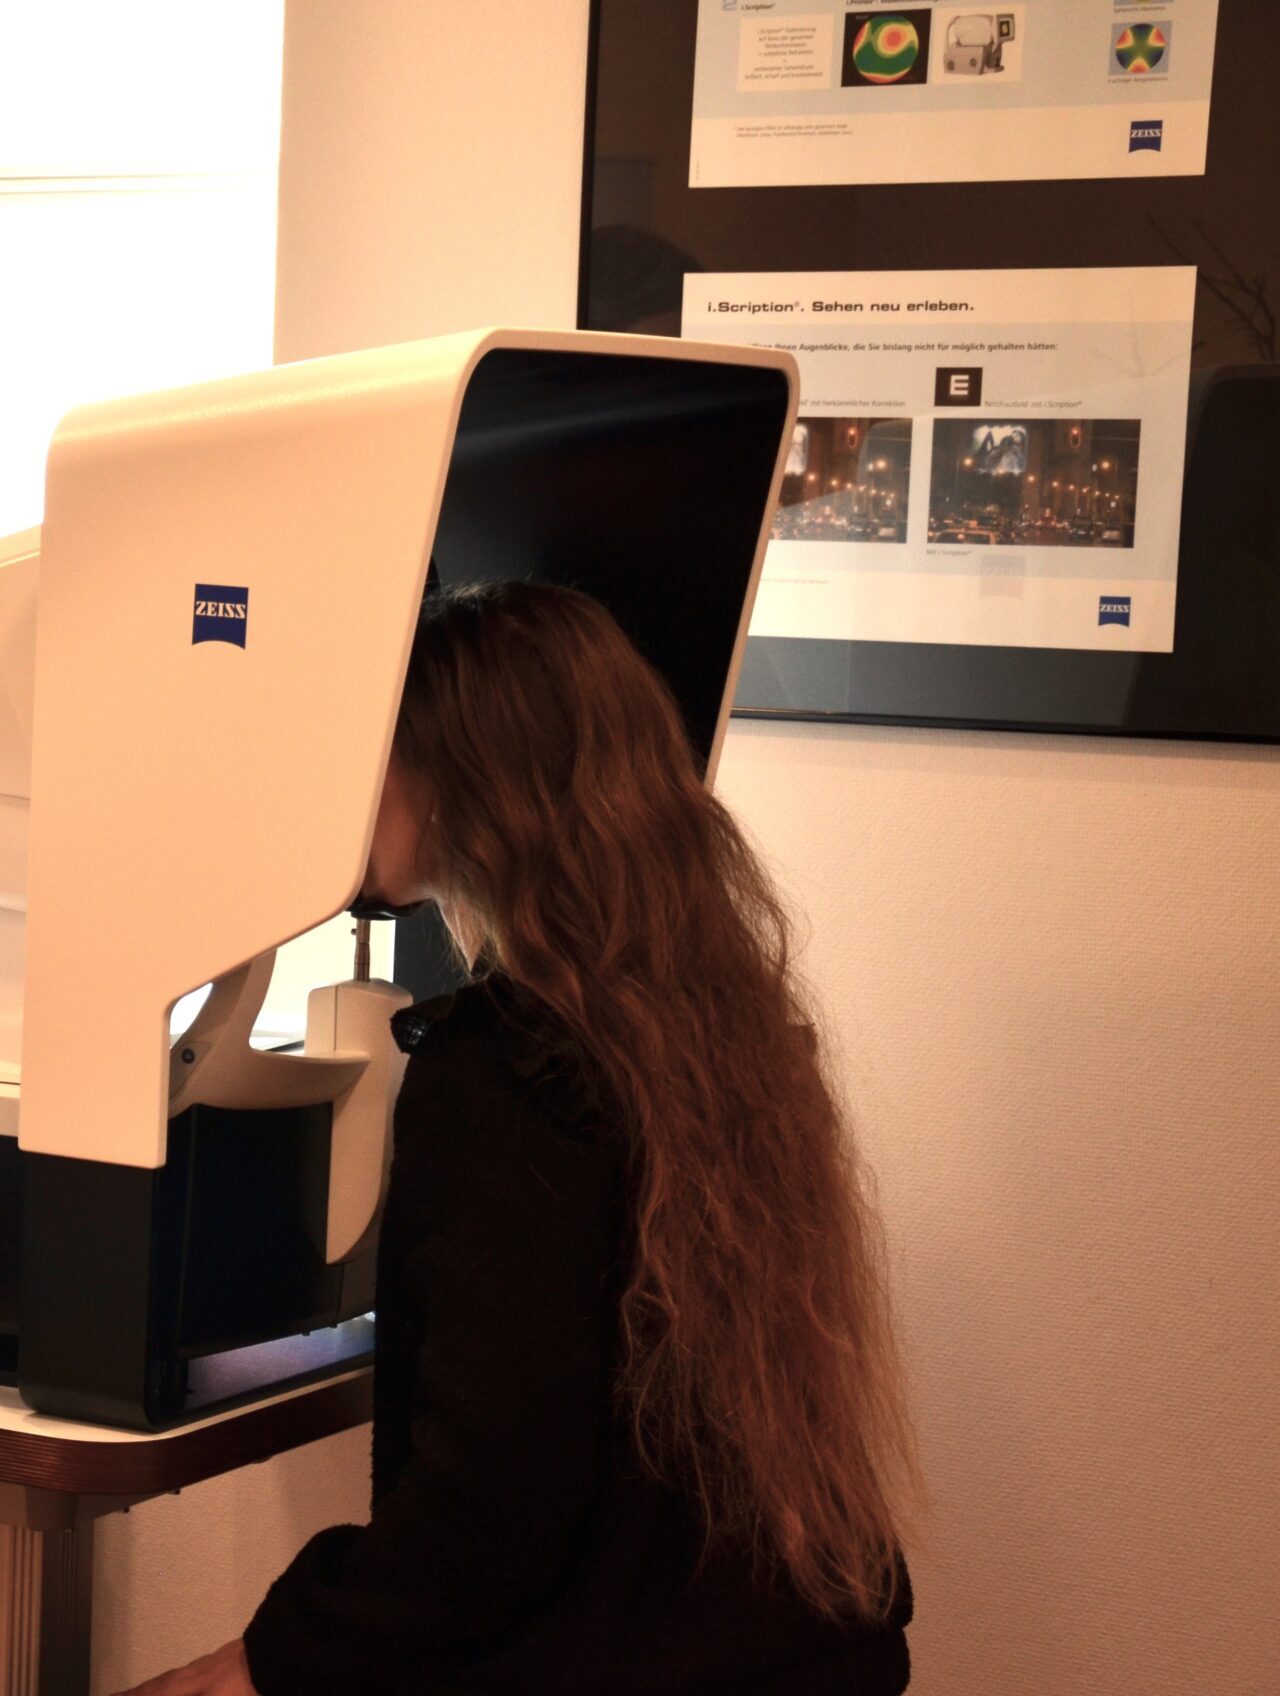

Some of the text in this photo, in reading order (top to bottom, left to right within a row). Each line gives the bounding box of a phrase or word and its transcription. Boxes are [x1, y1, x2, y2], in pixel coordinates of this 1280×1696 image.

[1131, 129, 1161, 138] ZEISS
[812, 301, 863, 312] Sehen
[870, 303, 900, 312] neu
[906, 300, 974, 312] erleben.
[799, 343, 850, 353] Augenblicke,
[883, 342, 912, 353] bislang
[914, 342, 935, 350] nicht
[938, 342, 949, 350] für
[952, 342, 985, 352] möglich
[987, 343, 1025, 352] gehalten
[950, 375, 969, 395] E
[195, 600, 246, 619] ZEISS
[1100, 604, 1129, 613] ZEISS
